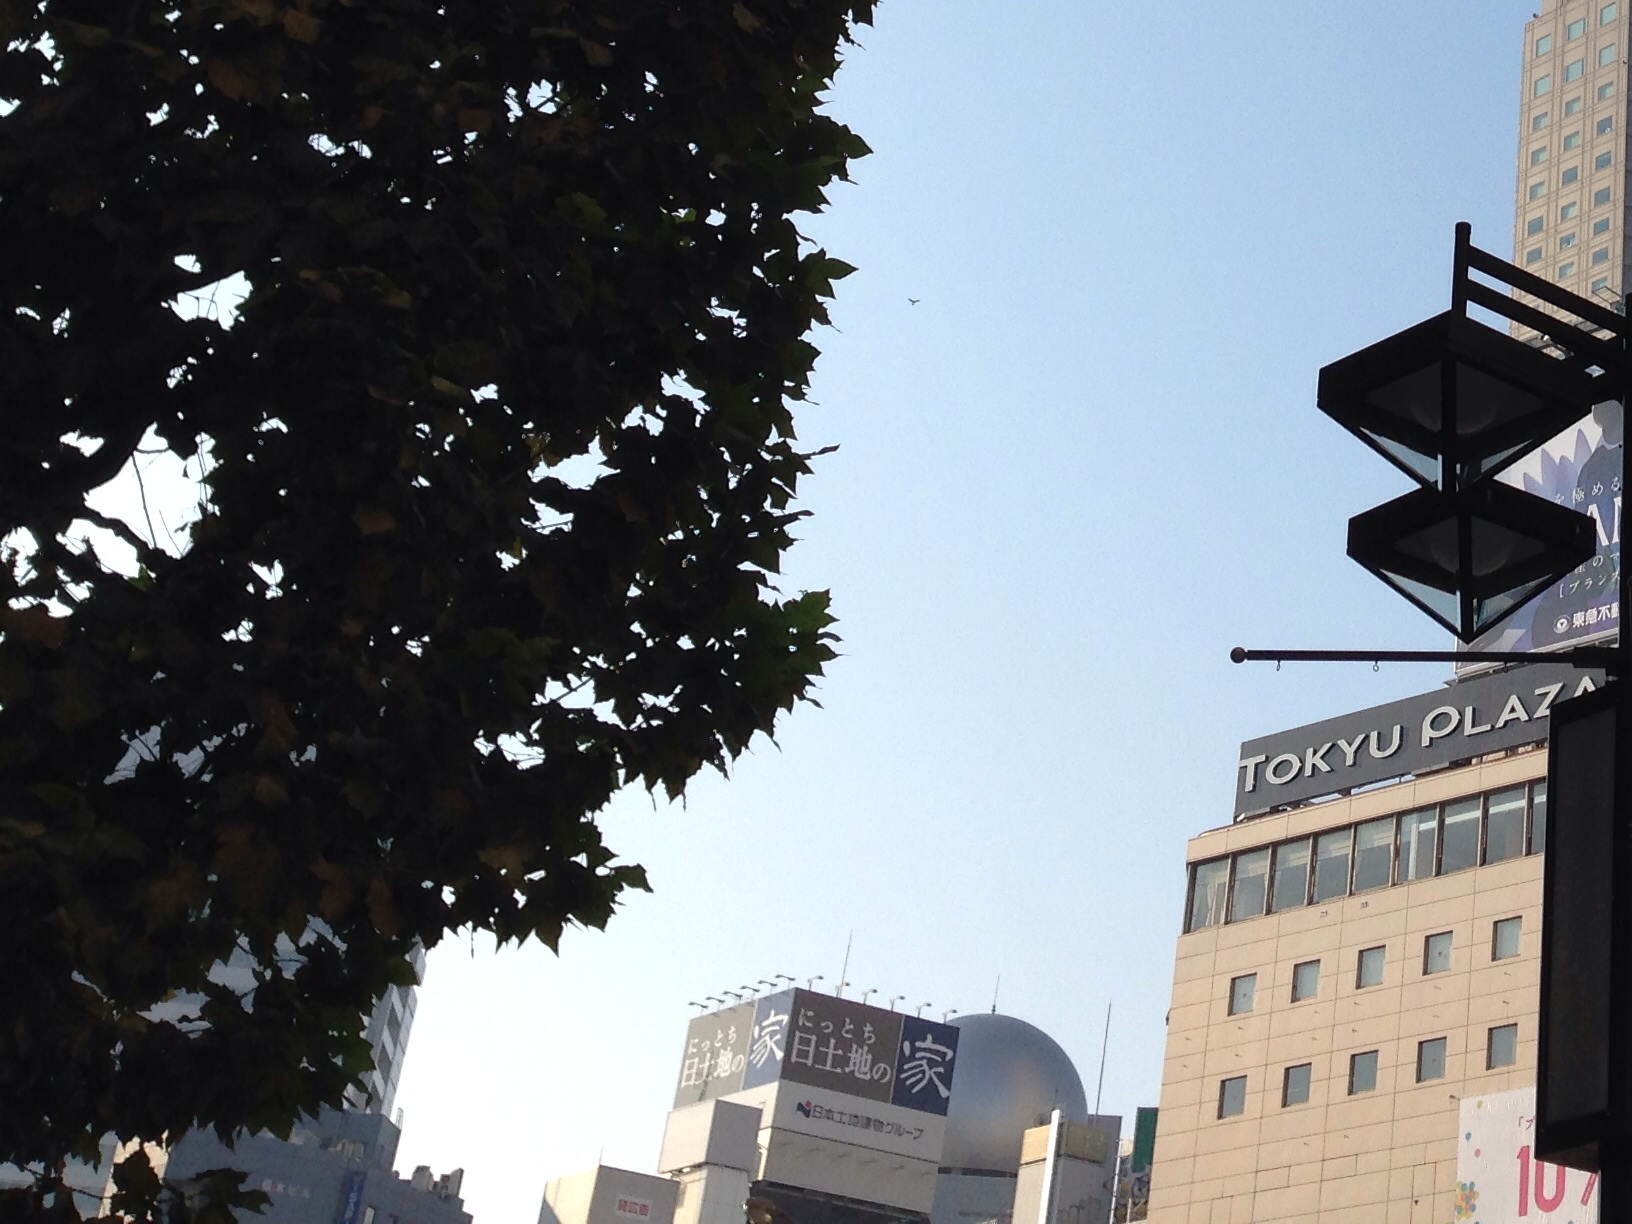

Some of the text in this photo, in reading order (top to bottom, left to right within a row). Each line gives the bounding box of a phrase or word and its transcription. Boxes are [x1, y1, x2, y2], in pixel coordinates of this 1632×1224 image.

[1239, 723, 1402, 793] TOKYU
[750, 1008, 789, 1069] 家
[798, 1007, 876, 1045] にっとち
[790, 1029, 954, 1099] 日土地の 家
